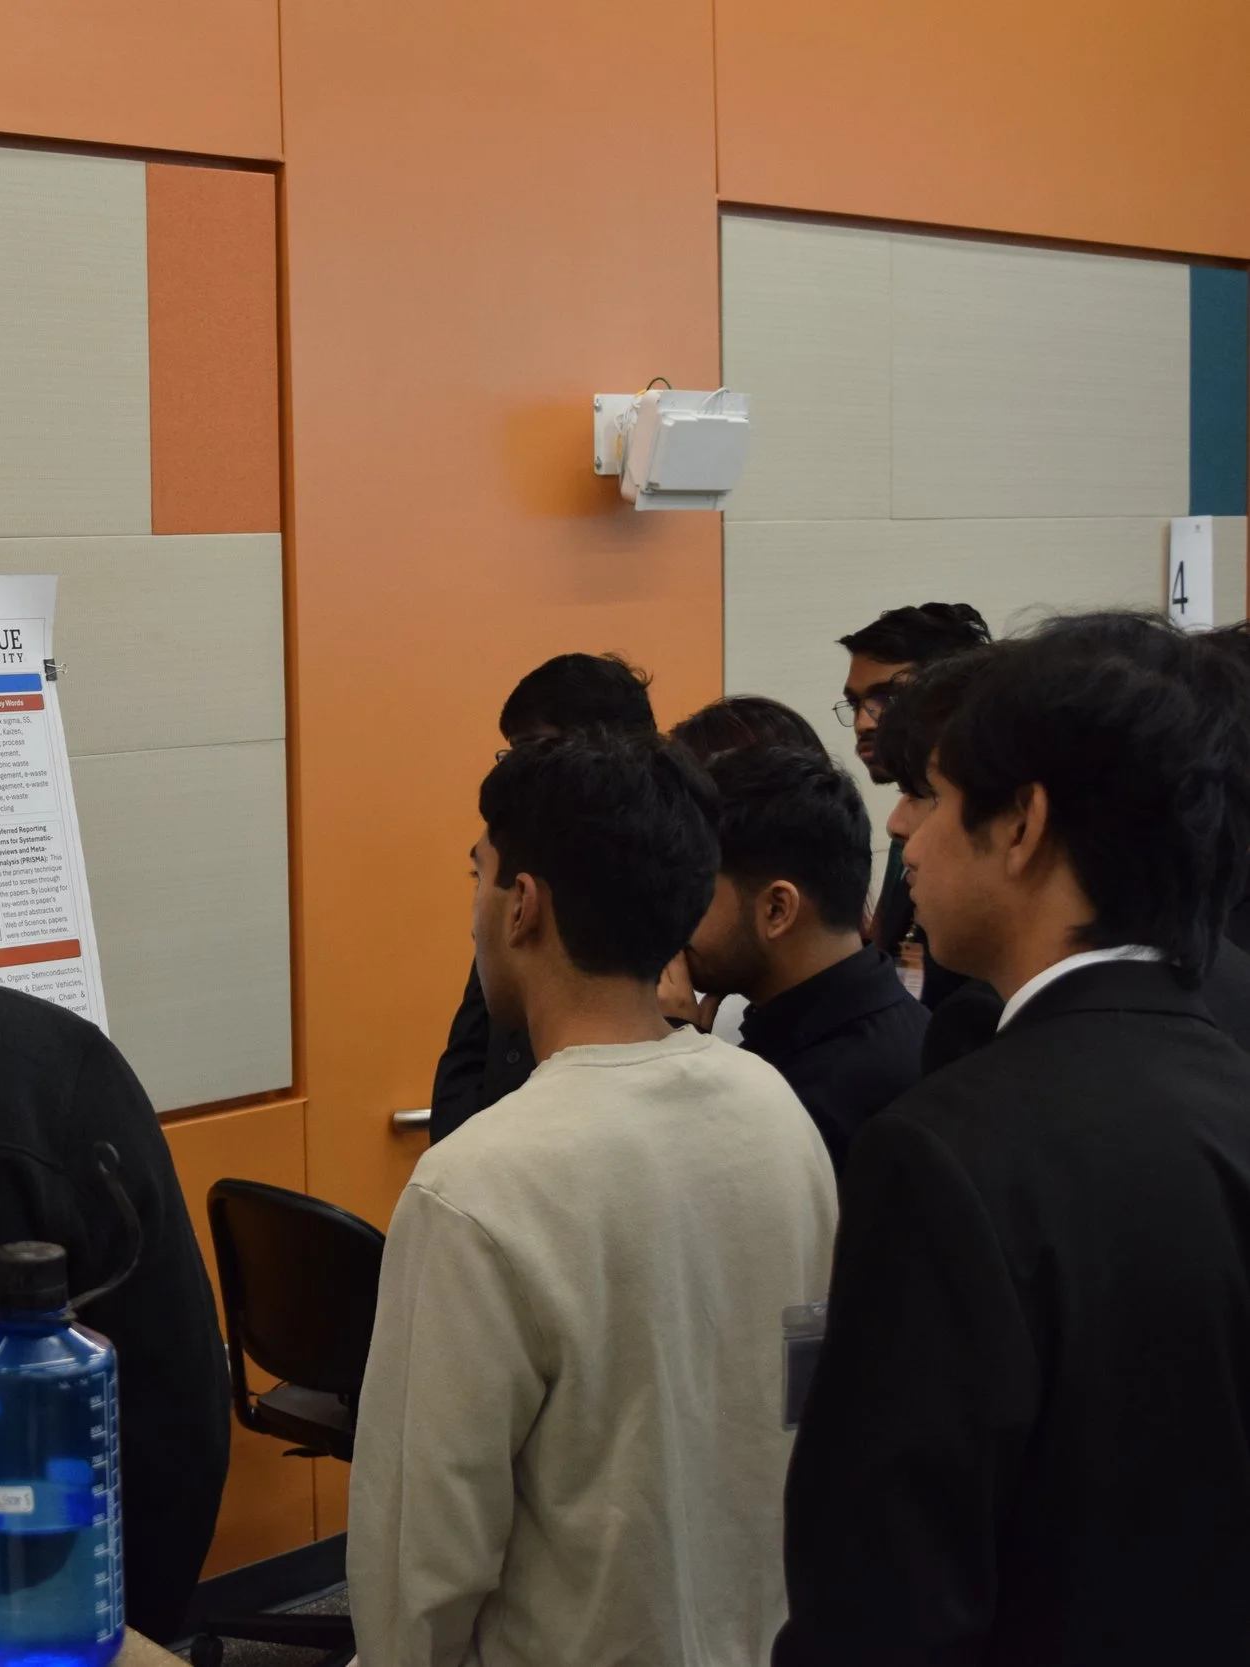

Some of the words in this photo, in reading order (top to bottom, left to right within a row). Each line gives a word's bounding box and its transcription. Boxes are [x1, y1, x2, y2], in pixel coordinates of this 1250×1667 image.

[1172, 560, 1188, 614] 4
[5, 699, 23, 707] Words
[18, 824, 46, 834] Reporting
[19, 834, 53, 845] Systematic-
[7, 972, 30, 983] Organic
